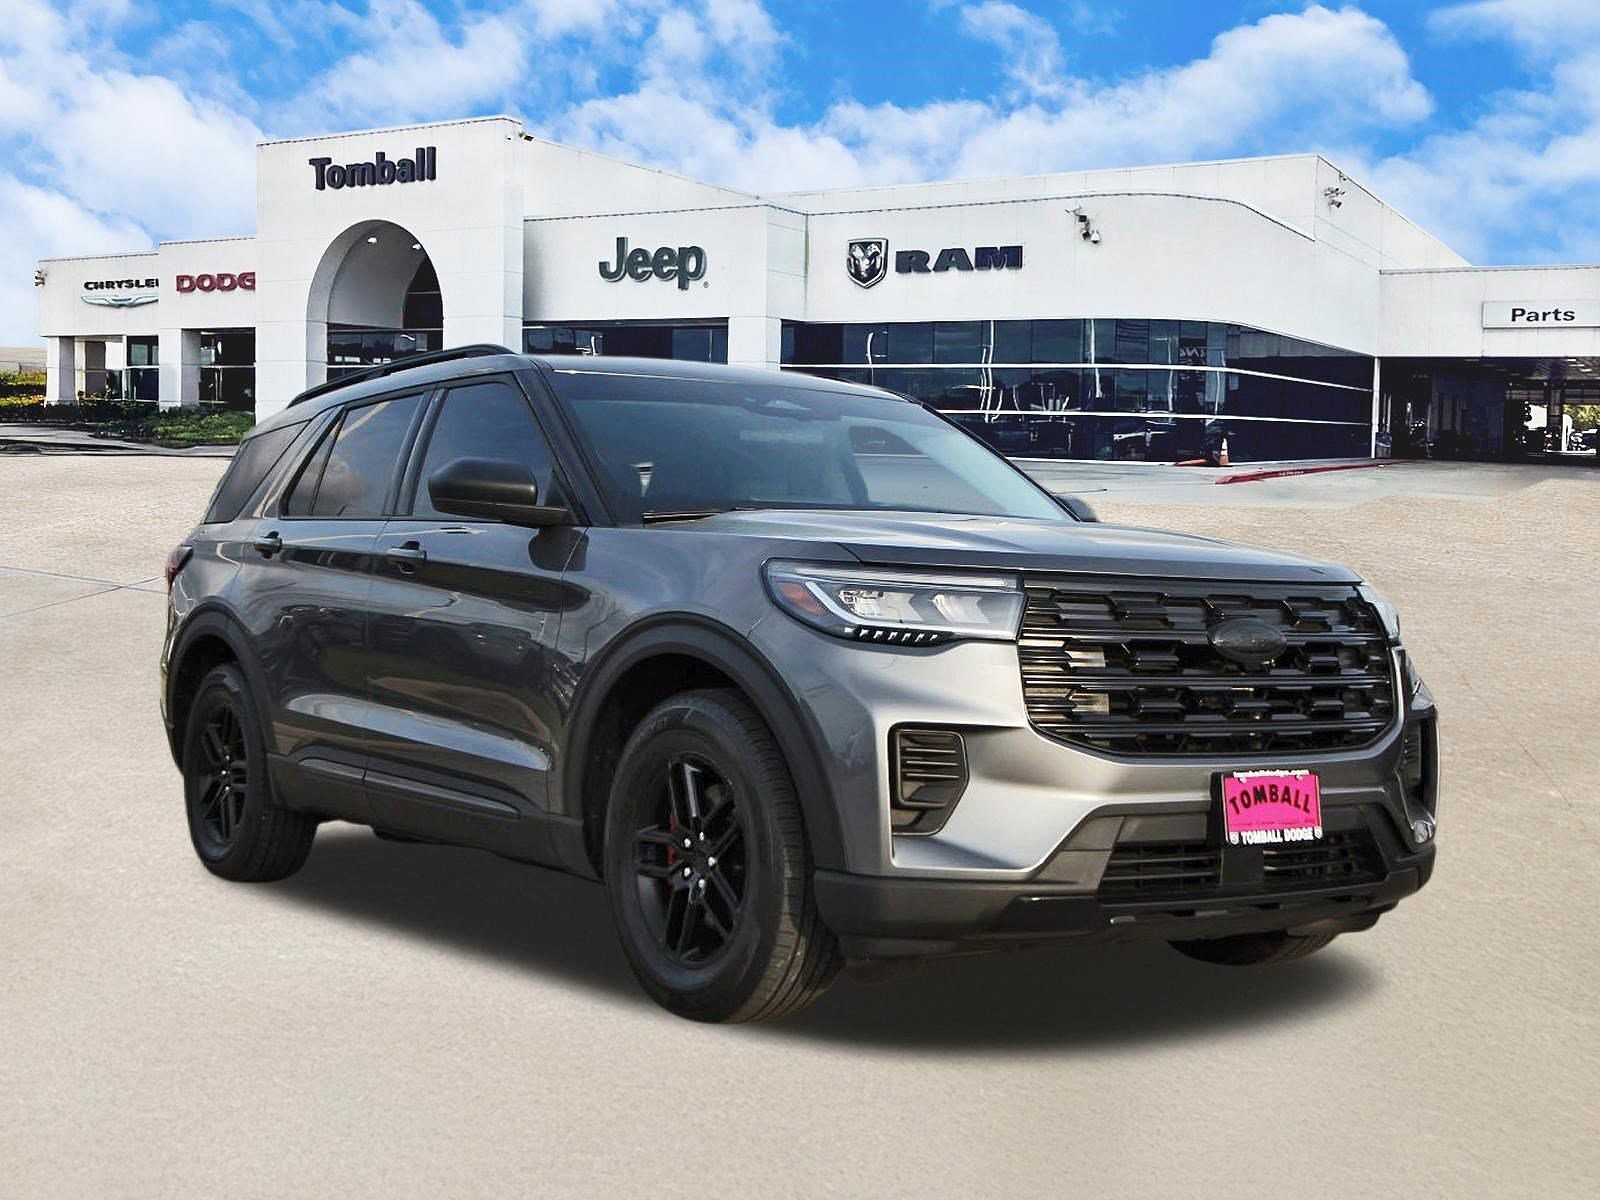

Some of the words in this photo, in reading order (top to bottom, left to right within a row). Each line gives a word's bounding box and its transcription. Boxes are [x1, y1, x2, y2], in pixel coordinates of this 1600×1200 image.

[308, 146, 436, 191] Tomball
[598, 236, 707, 291] Jeep
[895, 245, 1023, 273] RAM
[83, 278, 159, 290] CHRYSLE
[1511, 307, 1576, 322] Parts
[1229, 784, 1310, 815] TOMBALL
[1240, 829, 1283, 845] TOMBALL
[1284, 827, 1314, 842] DODGE
